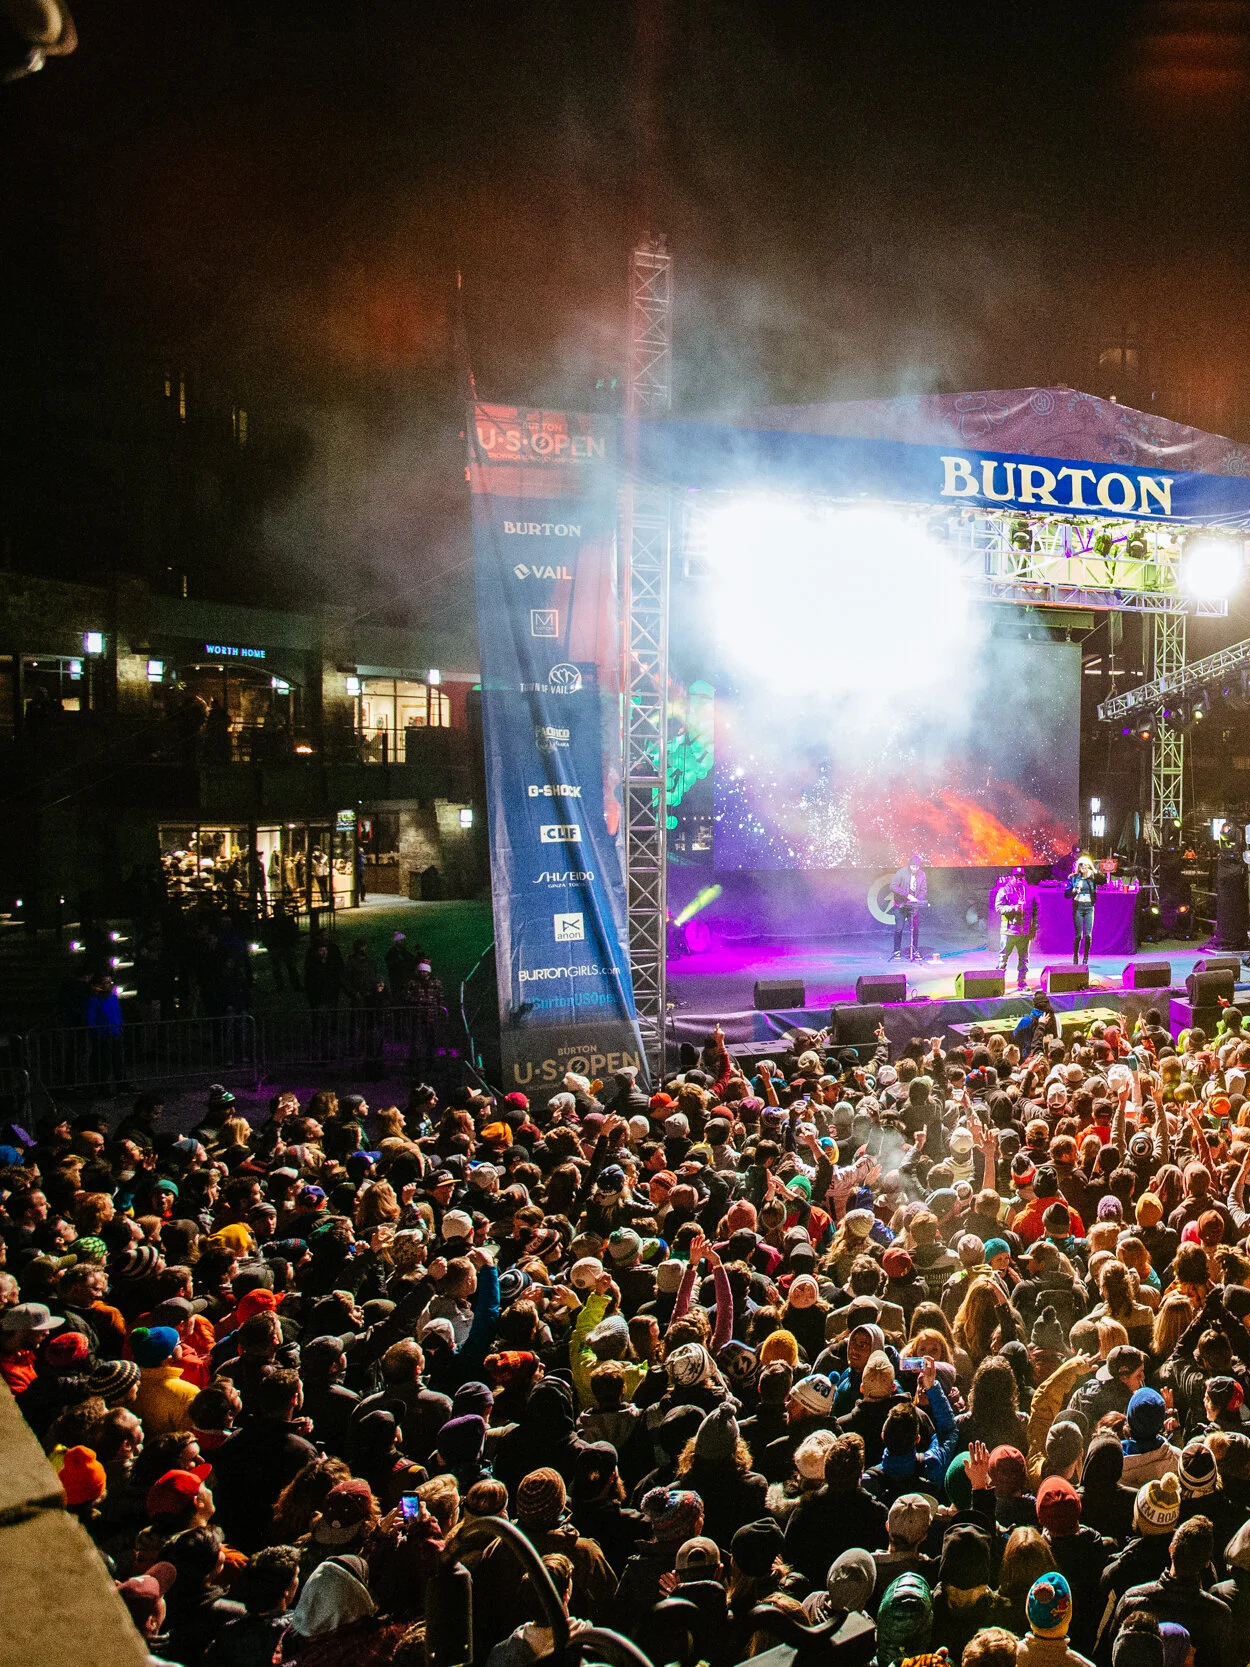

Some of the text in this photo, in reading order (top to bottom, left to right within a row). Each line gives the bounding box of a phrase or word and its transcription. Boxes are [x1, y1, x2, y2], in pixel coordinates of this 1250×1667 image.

[940, 456, 1174, 515] BURTON
[503, 520, 581, 538] BURTON
[532, 565, 571, 580] VAIL
[205, 644, 266, 659] WORTH HOME
[520, 683, 570, 695] TOWN OF VAIL
[528, 784, 582, 798] G-SHOCK
[546, 827, 577, 840] CLIF
[532, 871, 595, 884] SHISEIDO
[557, 1044, 598, 1056] BURTON
